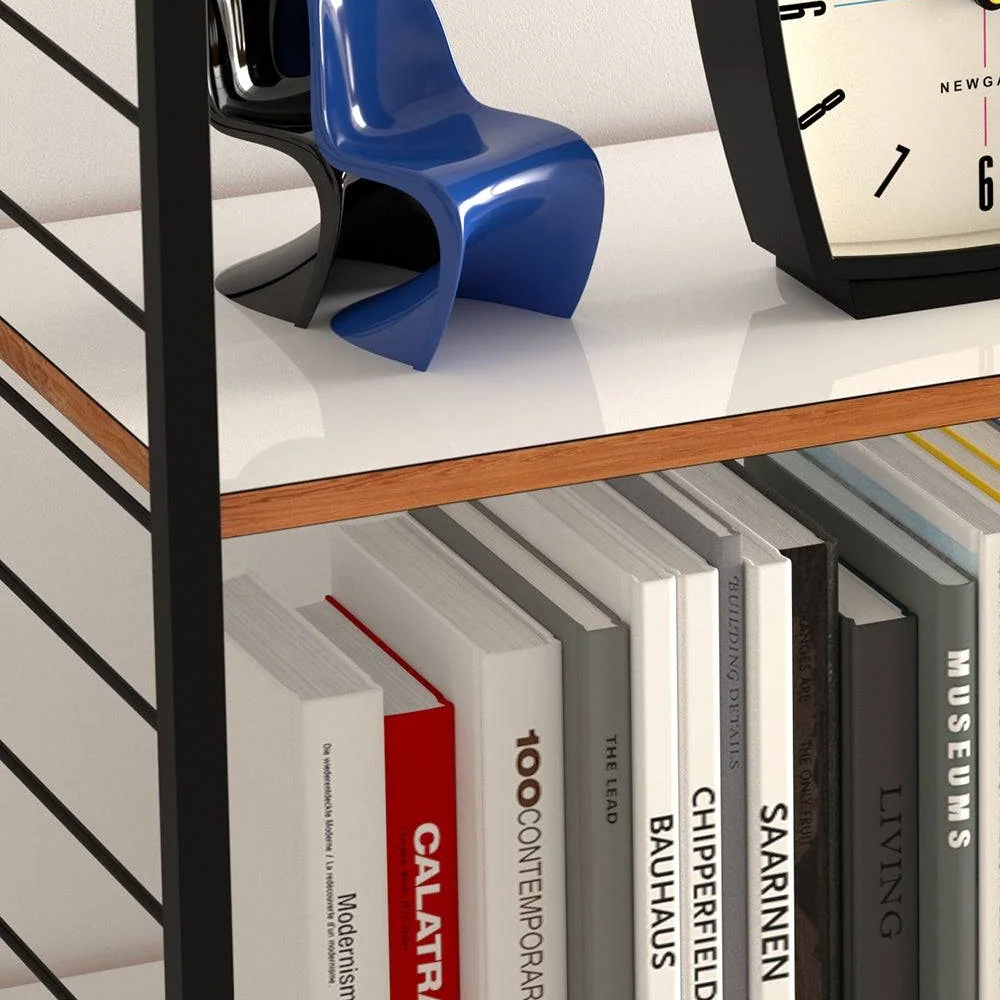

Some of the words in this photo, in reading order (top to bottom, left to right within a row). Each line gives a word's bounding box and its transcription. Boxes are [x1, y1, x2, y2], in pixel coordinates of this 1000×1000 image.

[778, 0, 827, 21] 9
[798, 88, 846, 131] 8
[873, 145, 911, 199] 7
[978, 155, 995, 213] 6
[726, 575, 741, 681] BUILDING
[604, 734, 618, 771] THE
[727, 688, 741, 771] DETAILS
[947, 648, 971, 850] MUSEUMS
[325, 820, 336, 853] Moderne
[605, 778, 619, 825] LEAD
[649, 814, 676, 970] BAUHAUS
[691, 786, 718, 1000] CHIPPERFIELD
[759, 802, 789, 983] SAARINEN
[879, 783, 903, 941] LIVING
[413, 822, 443, 1000] CALATR
